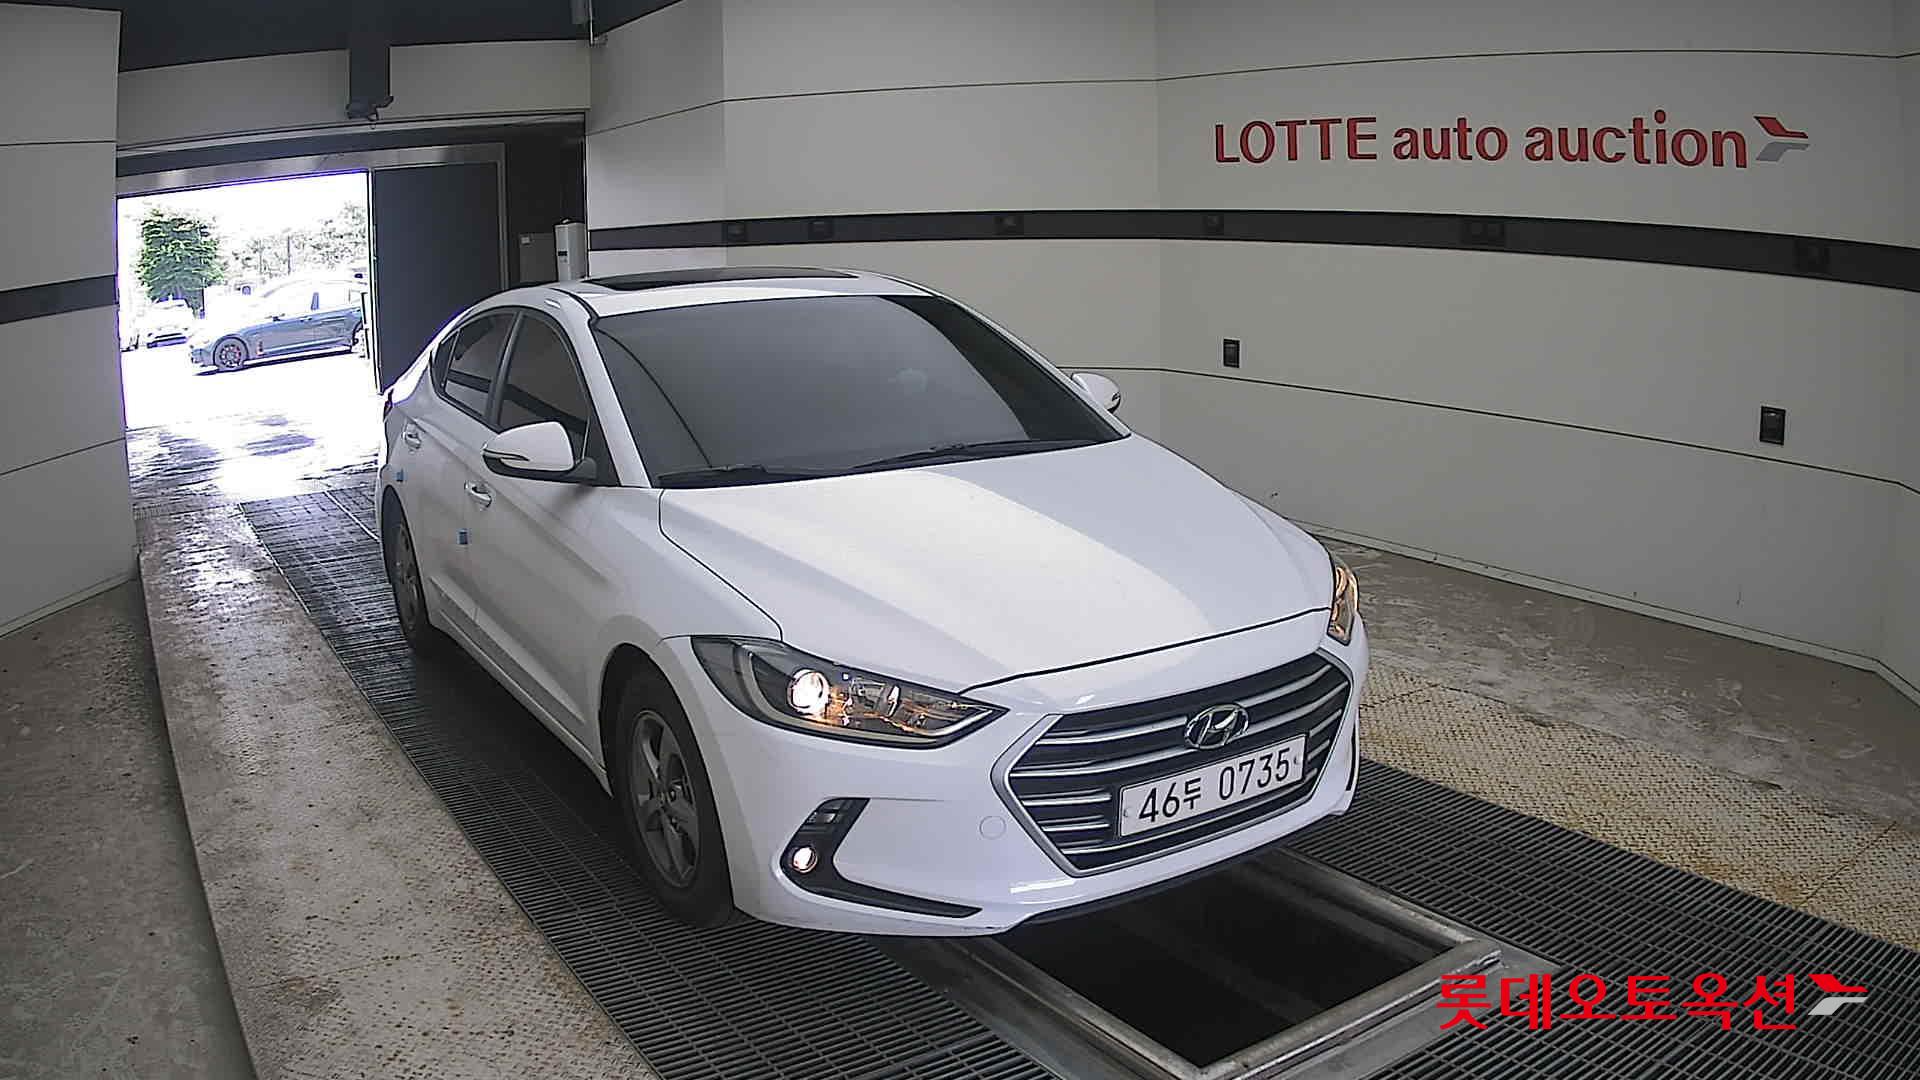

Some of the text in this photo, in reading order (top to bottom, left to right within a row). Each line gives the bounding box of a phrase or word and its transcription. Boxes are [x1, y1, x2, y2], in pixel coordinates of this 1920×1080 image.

[1215, 110, 1747, 168] LOTTE auto auction
[1138, 747, 1291, 823] 46두 0735
